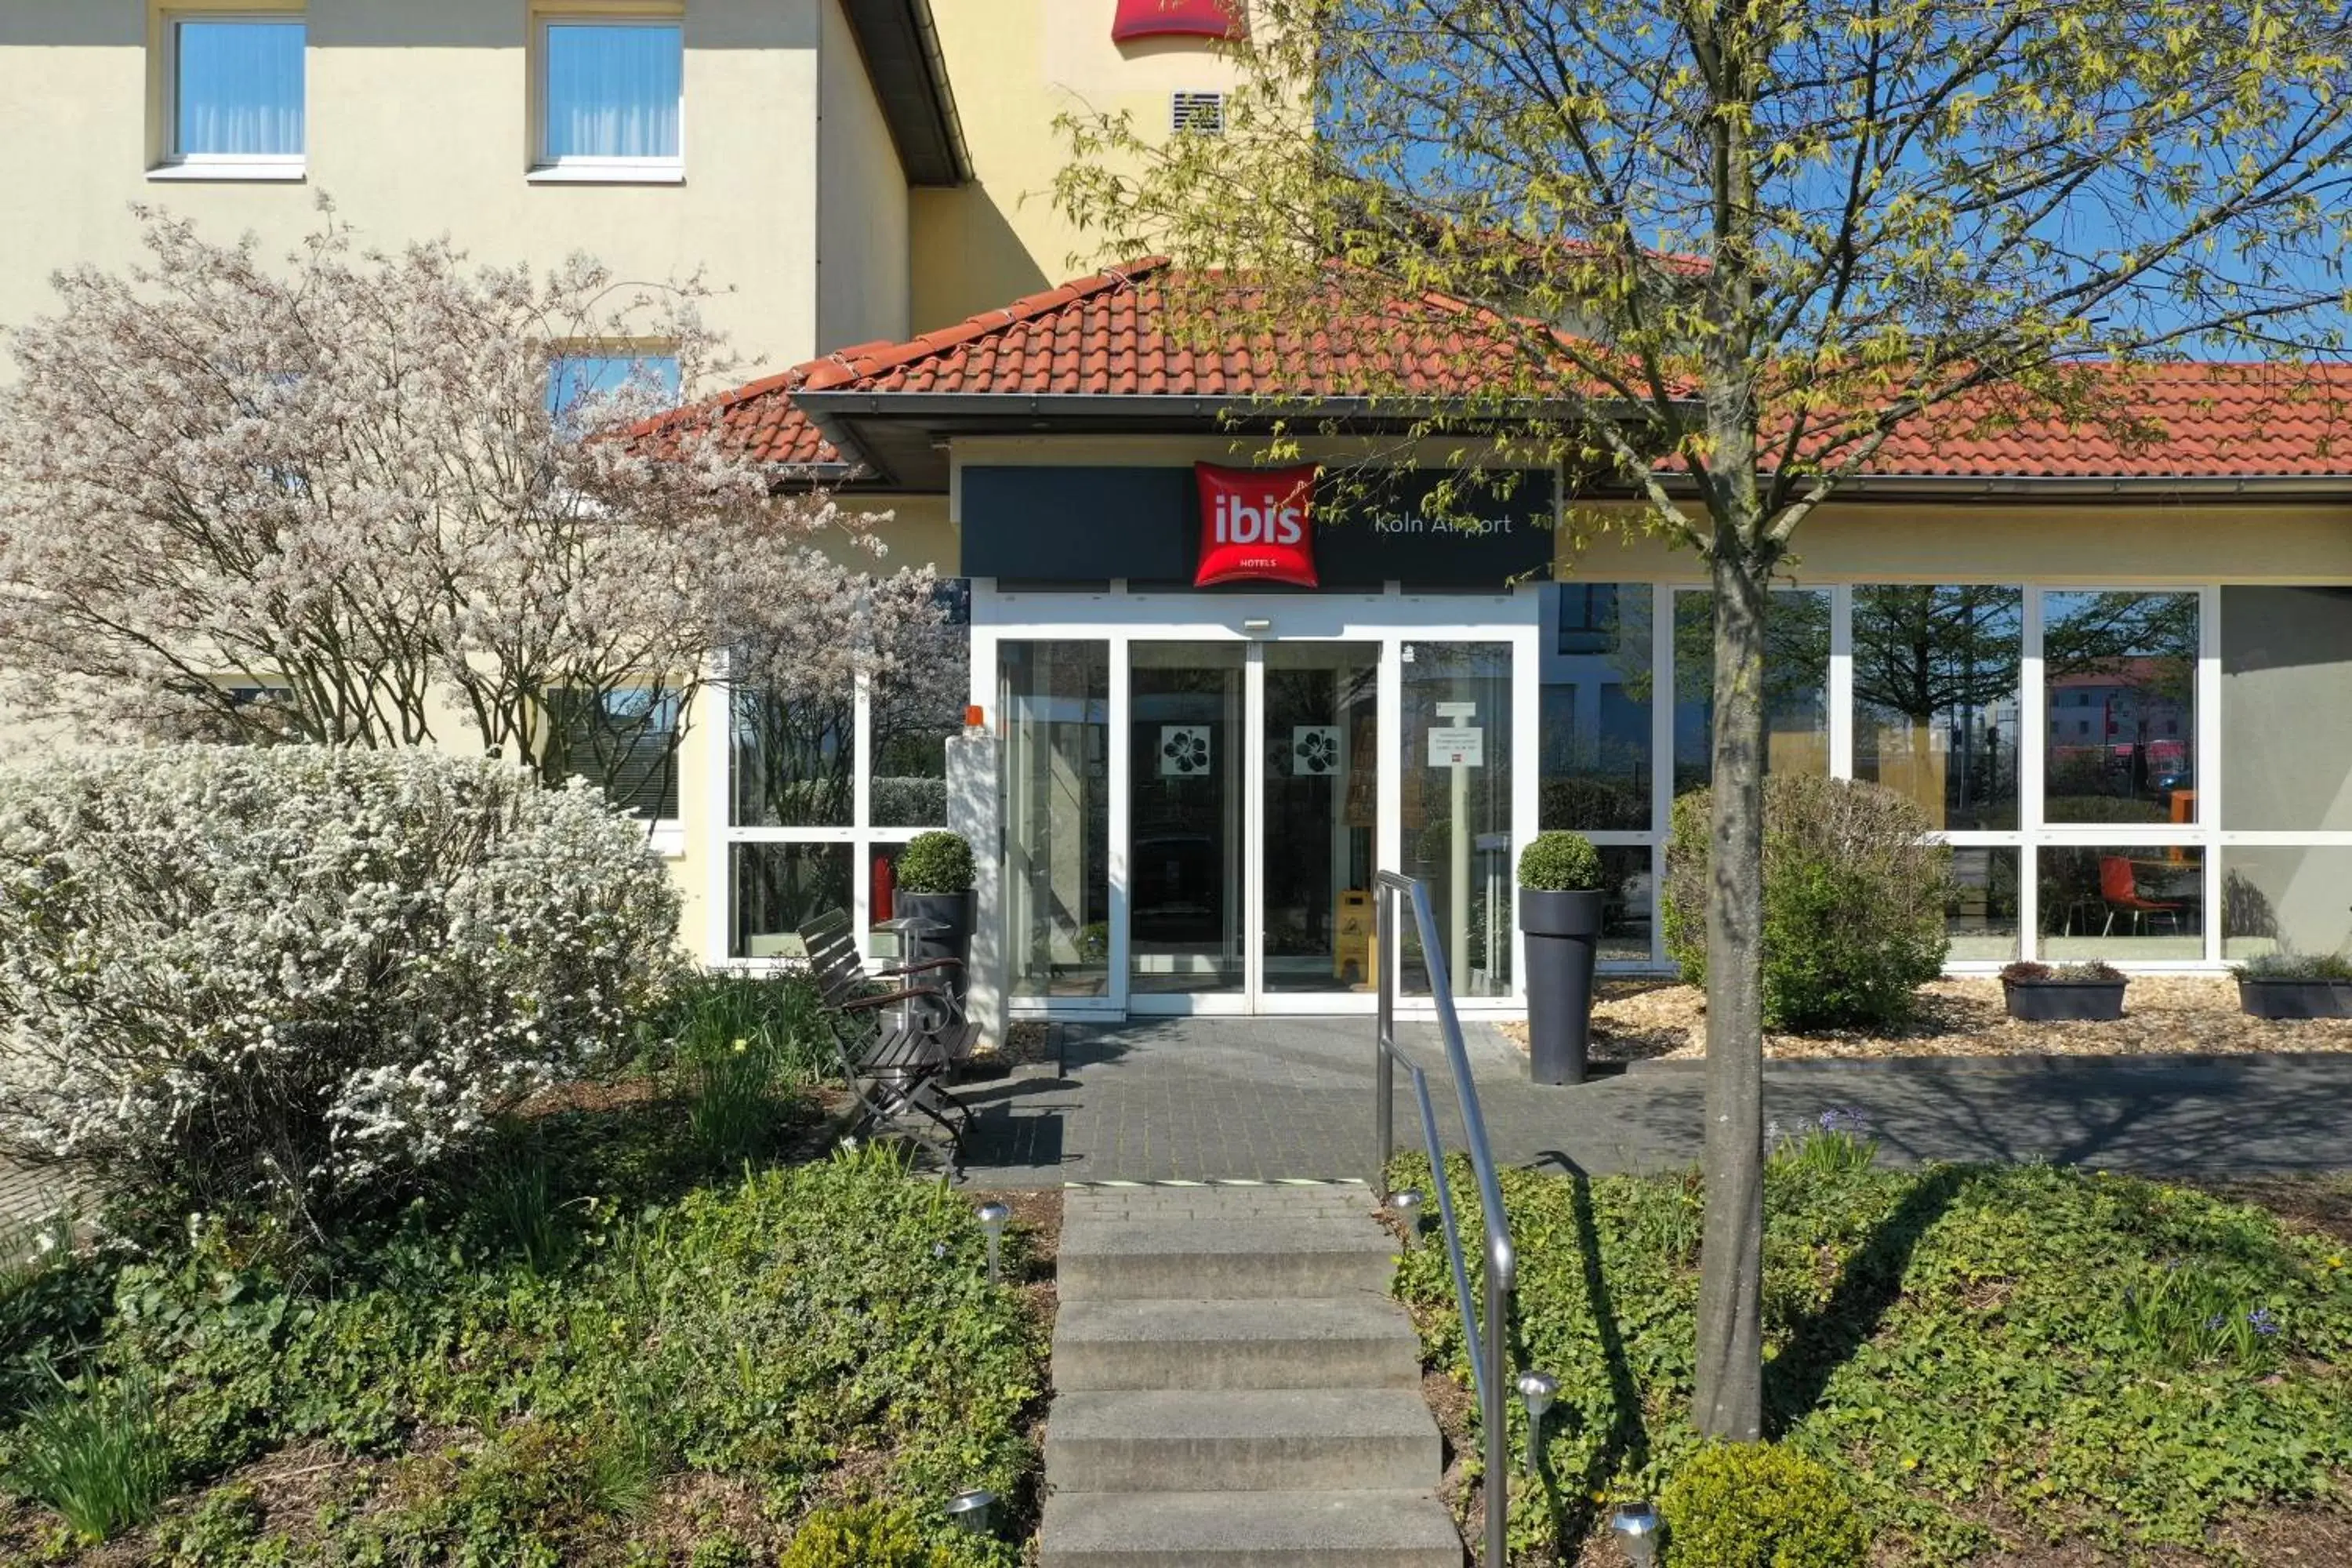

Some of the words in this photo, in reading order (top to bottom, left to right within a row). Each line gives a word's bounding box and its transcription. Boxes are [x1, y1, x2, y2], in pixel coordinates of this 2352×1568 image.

[1216, 495, 1301, 544] ibis
[1376, 510, 1423, 533] Köln
[1431, 513, 1512, 539] Aiort
[1240, 558, 1277, 568] HOTELS
